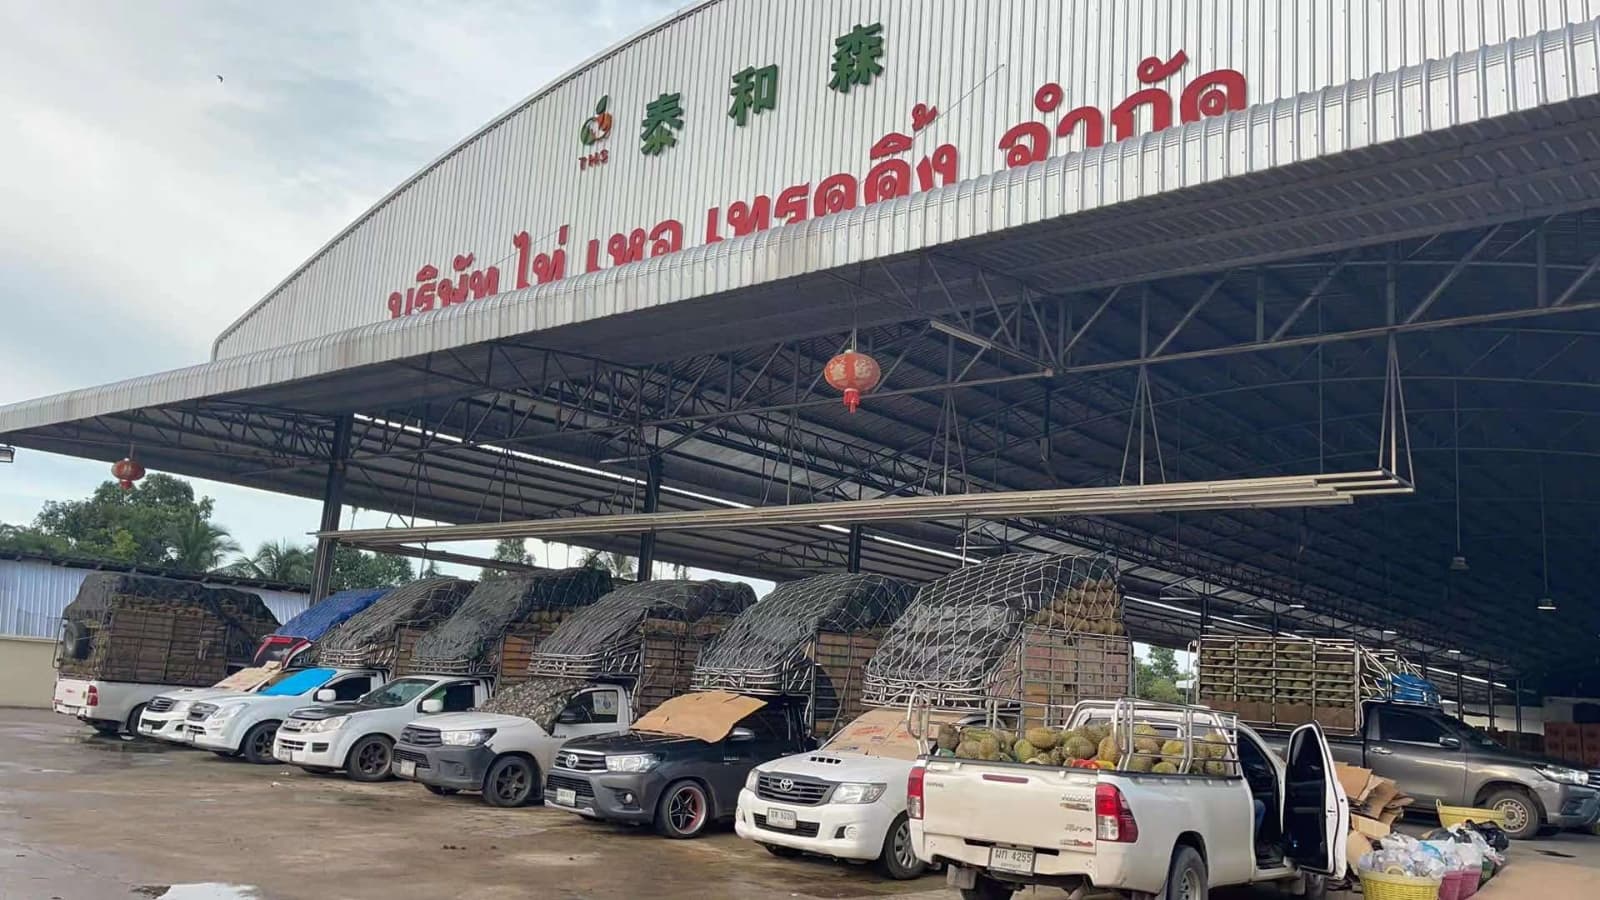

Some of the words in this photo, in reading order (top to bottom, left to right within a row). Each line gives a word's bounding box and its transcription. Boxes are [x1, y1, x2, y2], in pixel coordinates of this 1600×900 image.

[579, 149, 609, 171] THS
[388, 253, 500, 318] บริษัท
[513, 224, 569, 289] ไท่
[998, 50, 1247, 168] จำกัด
[1011, 851, 1032, 864] 4255
